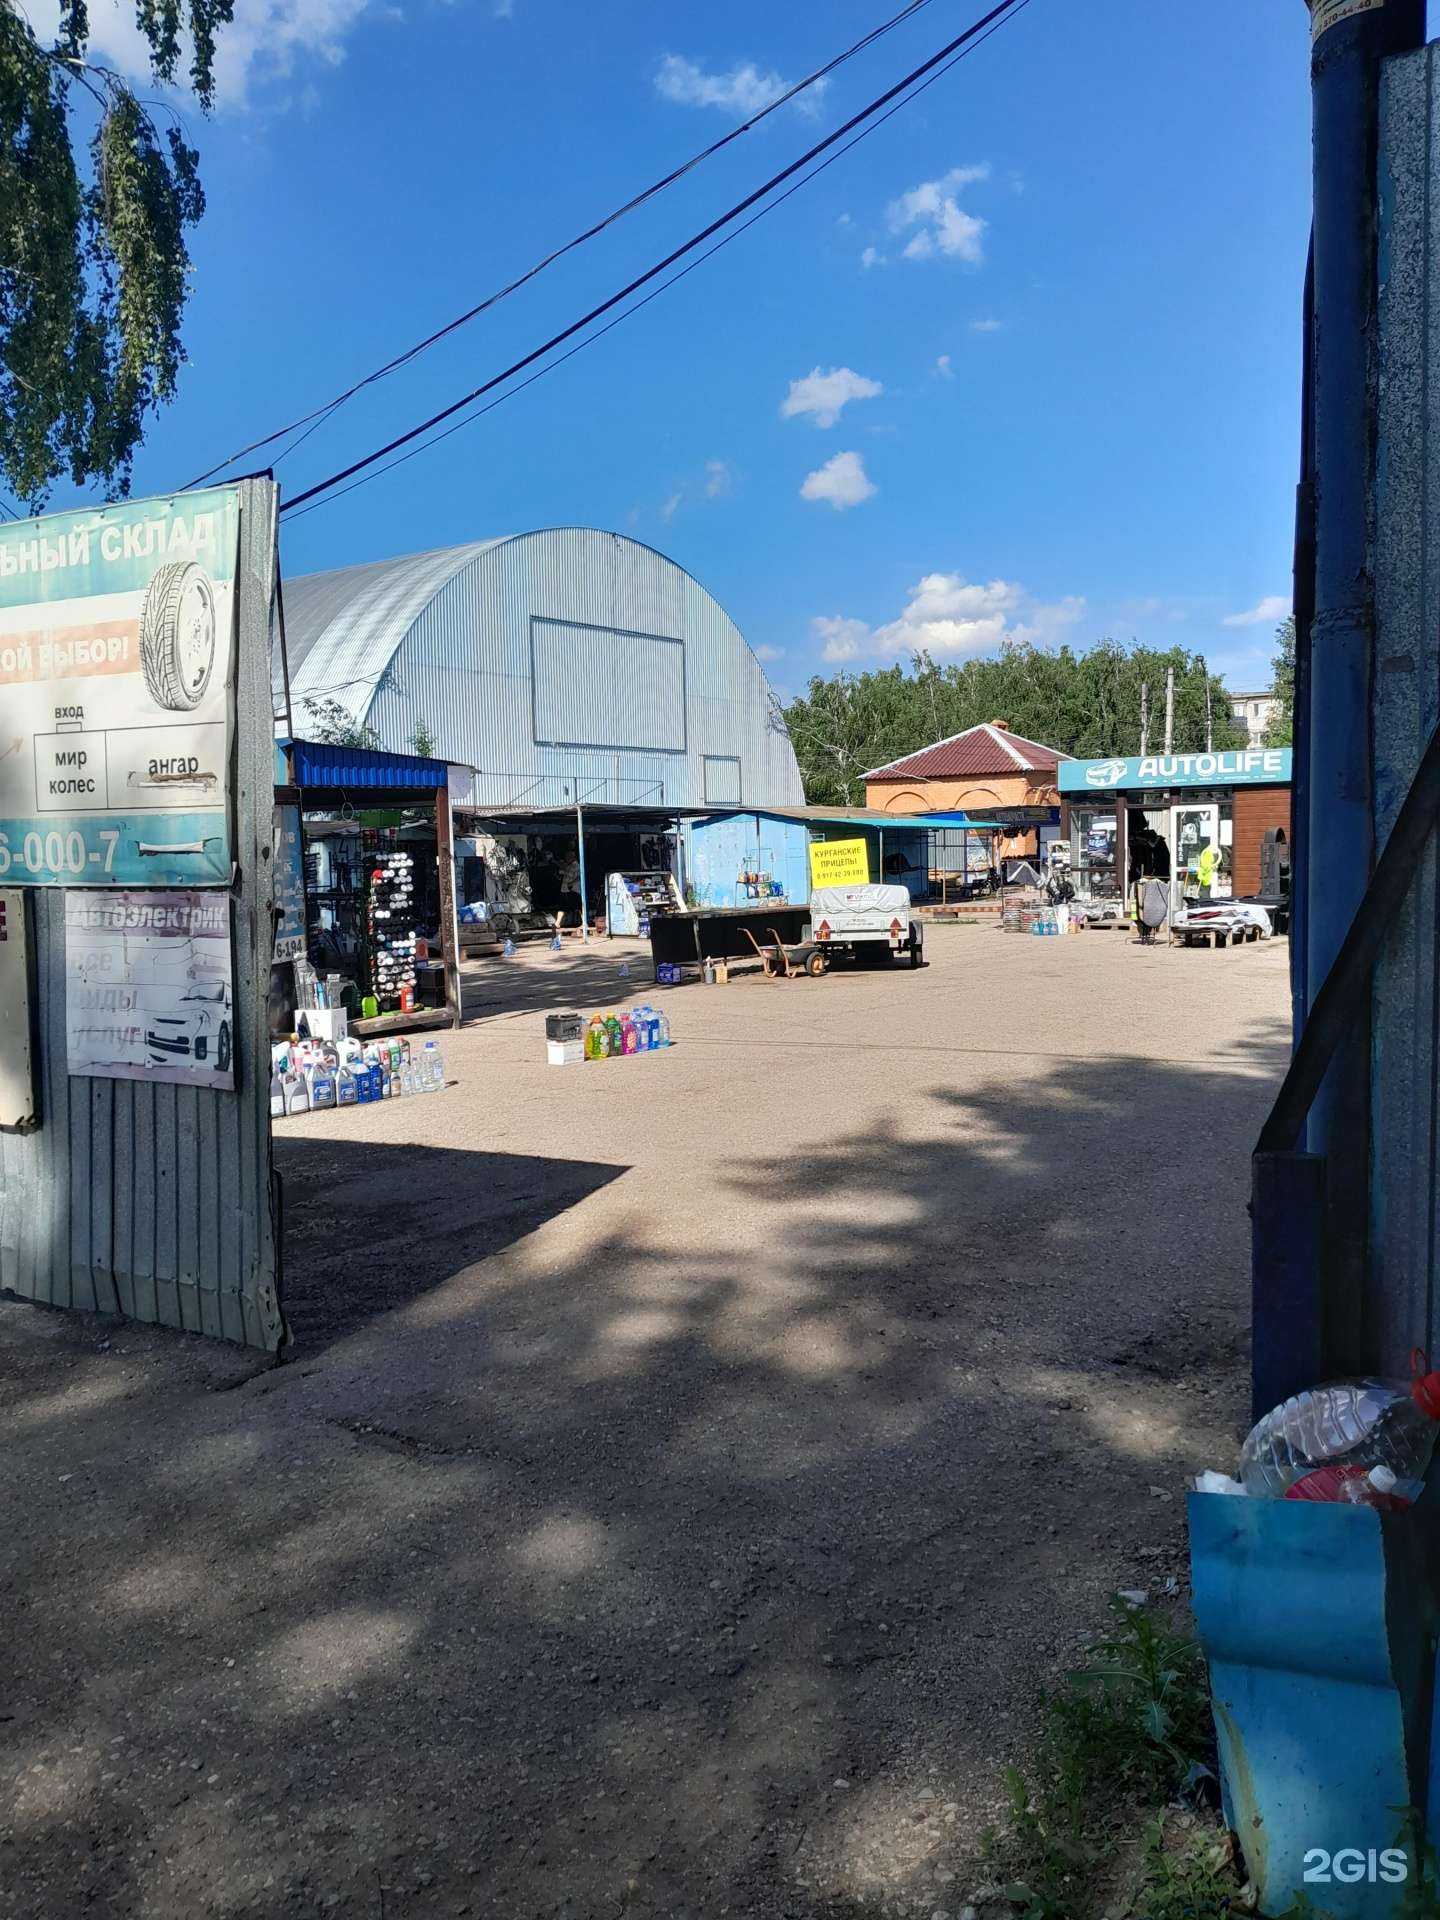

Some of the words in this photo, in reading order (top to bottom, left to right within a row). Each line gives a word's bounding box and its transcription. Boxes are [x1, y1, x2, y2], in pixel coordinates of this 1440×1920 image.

[100, 513, 216, 561] СКЛАД
[0, 643, 32, 673] ОЙ
[55, 705, 84, 719] вход
[55, 751, 87, 770] мир
[149, 757, 199, 775] ангар
[1138, 751, 1283, 778] AUTOLIFE
[50, 778, 96, 794] колес
[814, 846, 862, 858] КУРГАНСКИЕ
